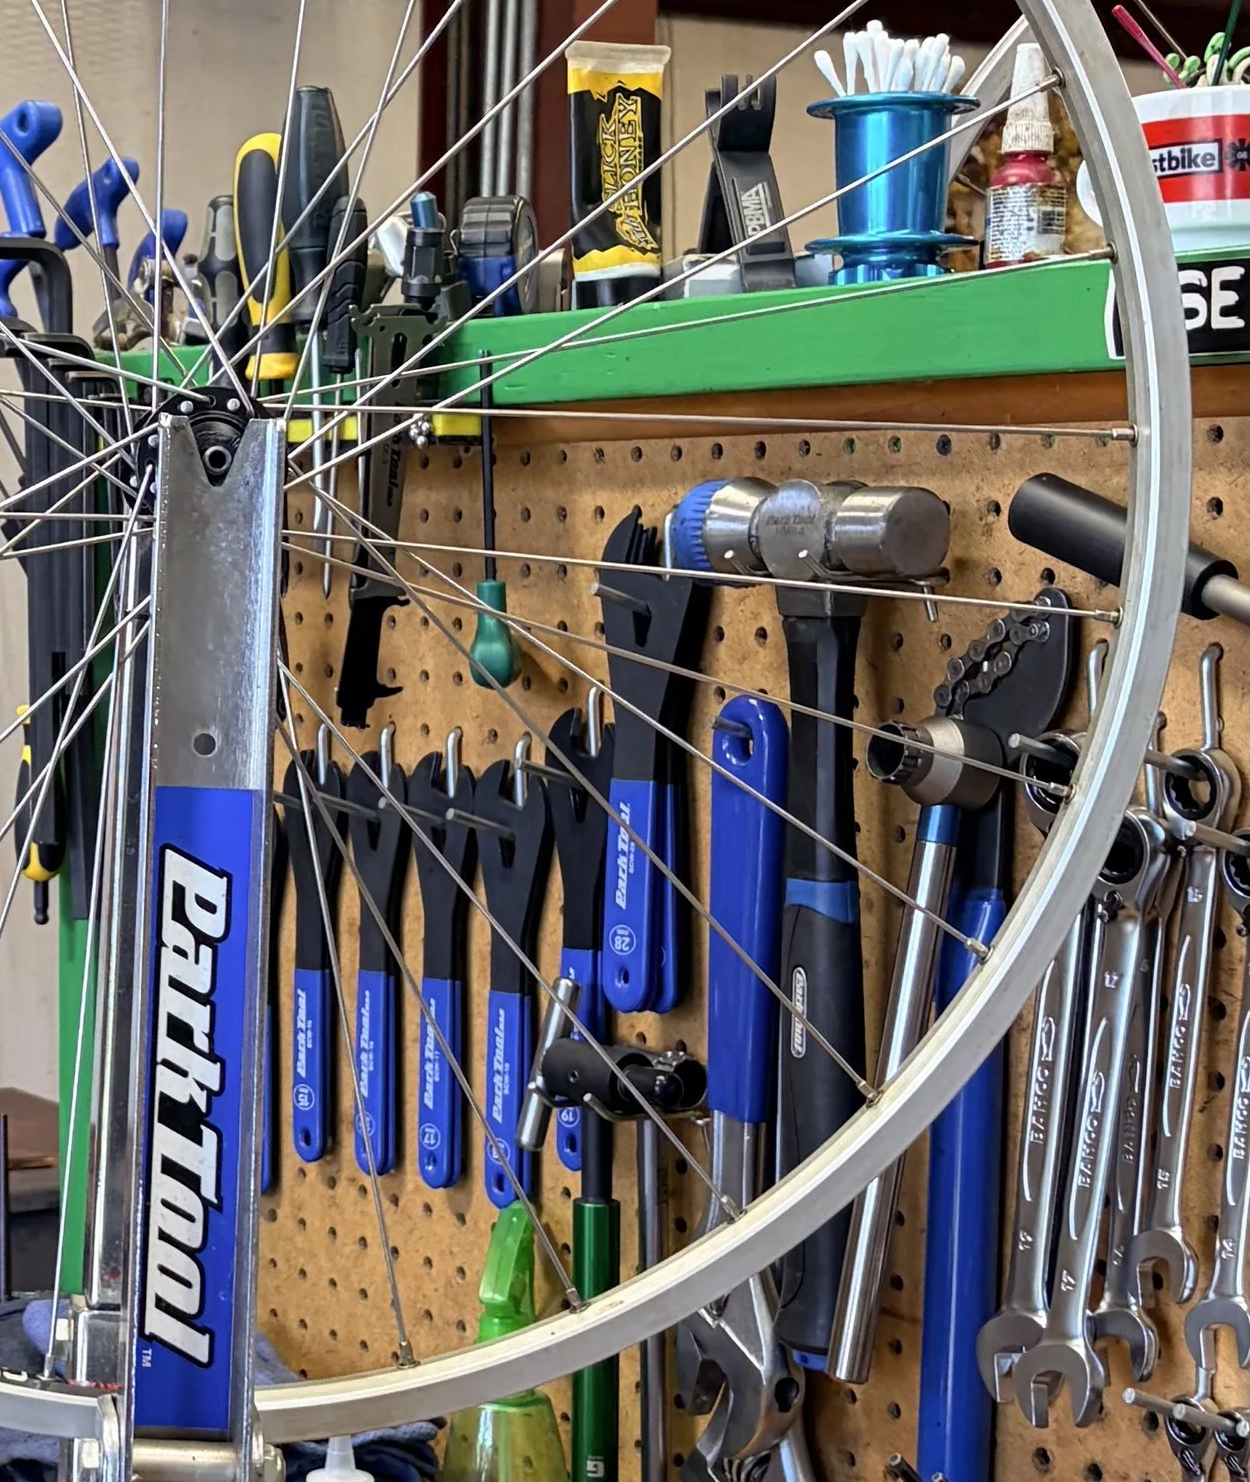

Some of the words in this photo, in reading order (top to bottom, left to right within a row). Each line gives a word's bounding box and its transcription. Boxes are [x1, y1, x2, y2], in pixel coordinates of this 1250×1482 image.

[617, 95, 641, 211] HONEY
[1178, 266, 1246, 330] SE
[614, 935, 631, 951] 28
[1169, 1023, 1187, 1090] BAHCO
[1030, 1066, 1050, 1144] BAHCO
[1232, 1094, 1249, 1161] BAHCO
[1077, 1117, 1098, 1188] BAHCO
